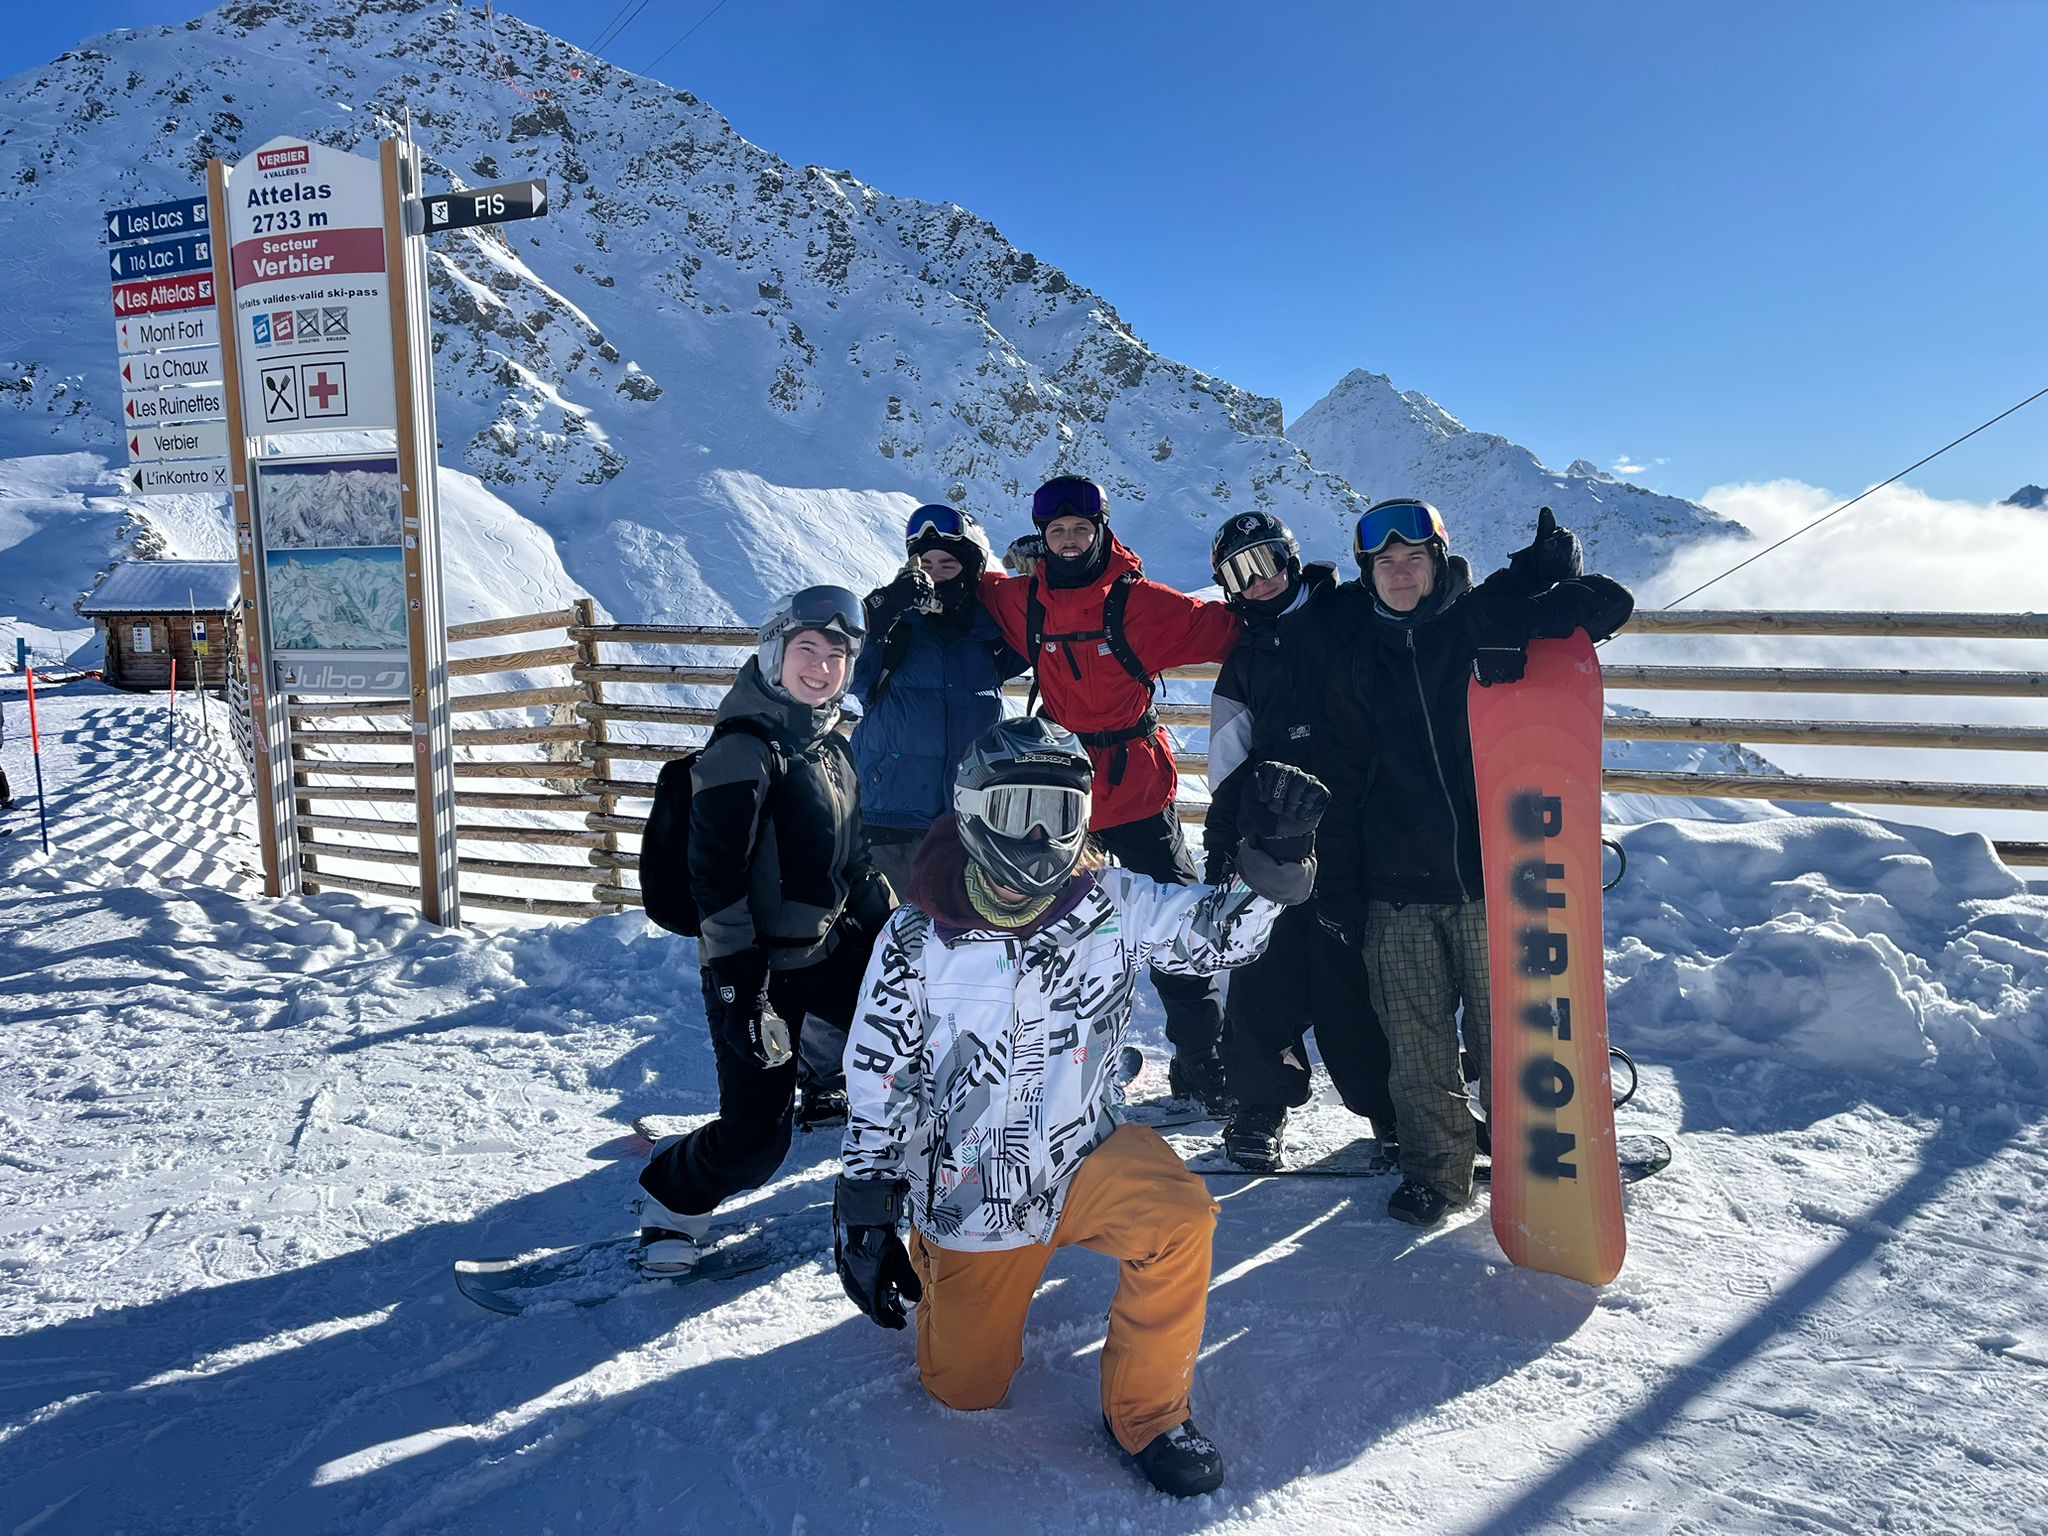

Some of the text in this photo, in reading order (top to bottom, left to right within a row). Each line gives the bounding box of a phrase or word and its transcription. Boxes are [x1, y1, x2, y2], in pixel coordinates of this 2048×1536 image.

[260, 150, 306, 167] VERBIER
[263, 168, 300, 180] 4 VALLÉES
[247, 182, 332, 208] Attelas
[474, 193, 505, 218] FIS
[127, 211, 184, 234] Les Lacs
[252, 210, 328, 234] 2733 m
[262, 238, 318, 254] Secteur
[129, 245, 184, 272] 116 Lac 1
[253, 253, 334, 278] Verbier
[125, 284, 196, 309] Les Attelas
[262, 289, 324, 305] valides-valid
[327, 288, 379, 299] ski-pass
[140, 319, 204, 343] Mont Fort
[143, 359, 209, 380] La Chaux
[135, 394, 220, 417] Les Ruinettes
[154, 434, 199, 451] Verbier
[146, 470, 209, 485] L'inKontro
[763, 618, 790, 642] GIRO
[284, 665, 366, 689] Julbo
[1014, 753, 1072, 766] SIXSIXONE
[1509, 790, 1577, 1181] BURTON
